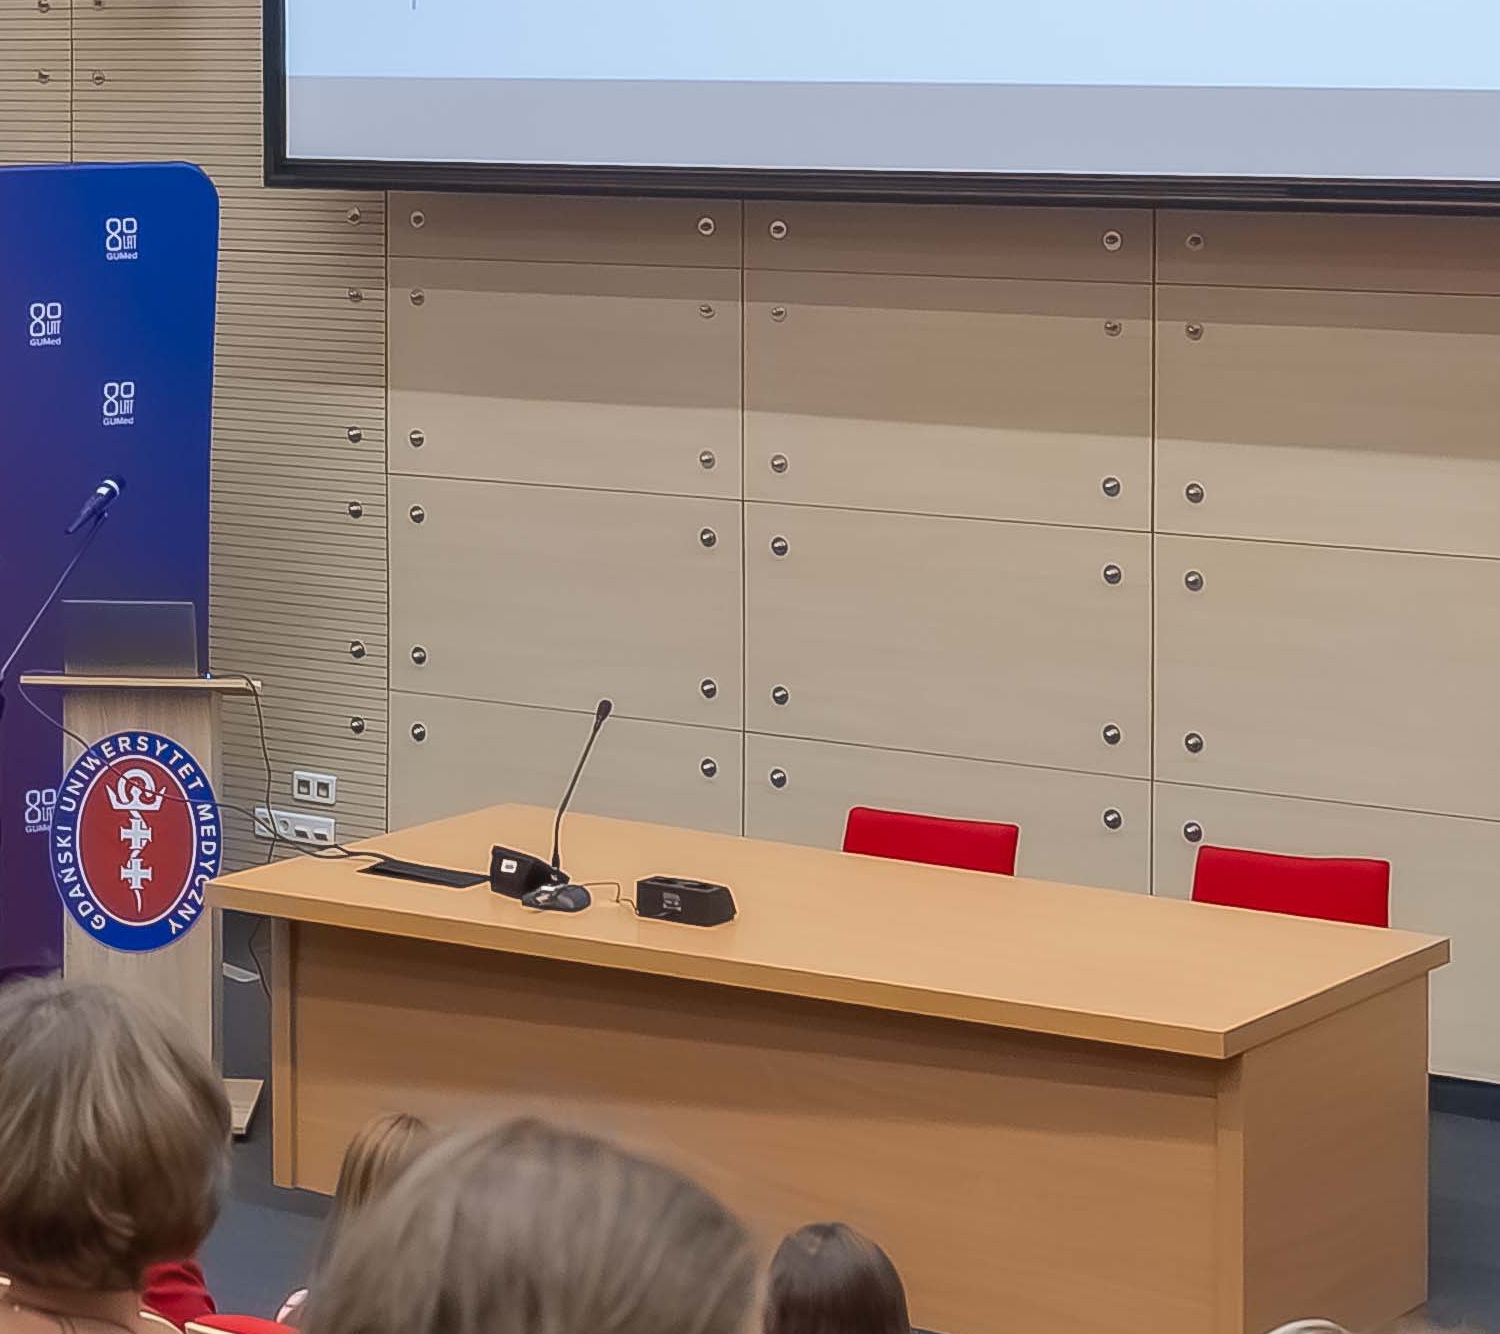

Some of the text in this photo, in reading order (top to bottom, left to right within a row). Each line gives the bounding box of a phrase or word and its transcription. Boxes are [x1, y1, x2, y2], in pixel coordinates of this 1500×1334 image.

[105, 217, 137, 250] 80
[30, 302, 61, 336] 80
[103, 382, 134, 416] 80
[56, 735, 217, 935] GDAŃSKI UNIWERSYTET MEDYCZNY
